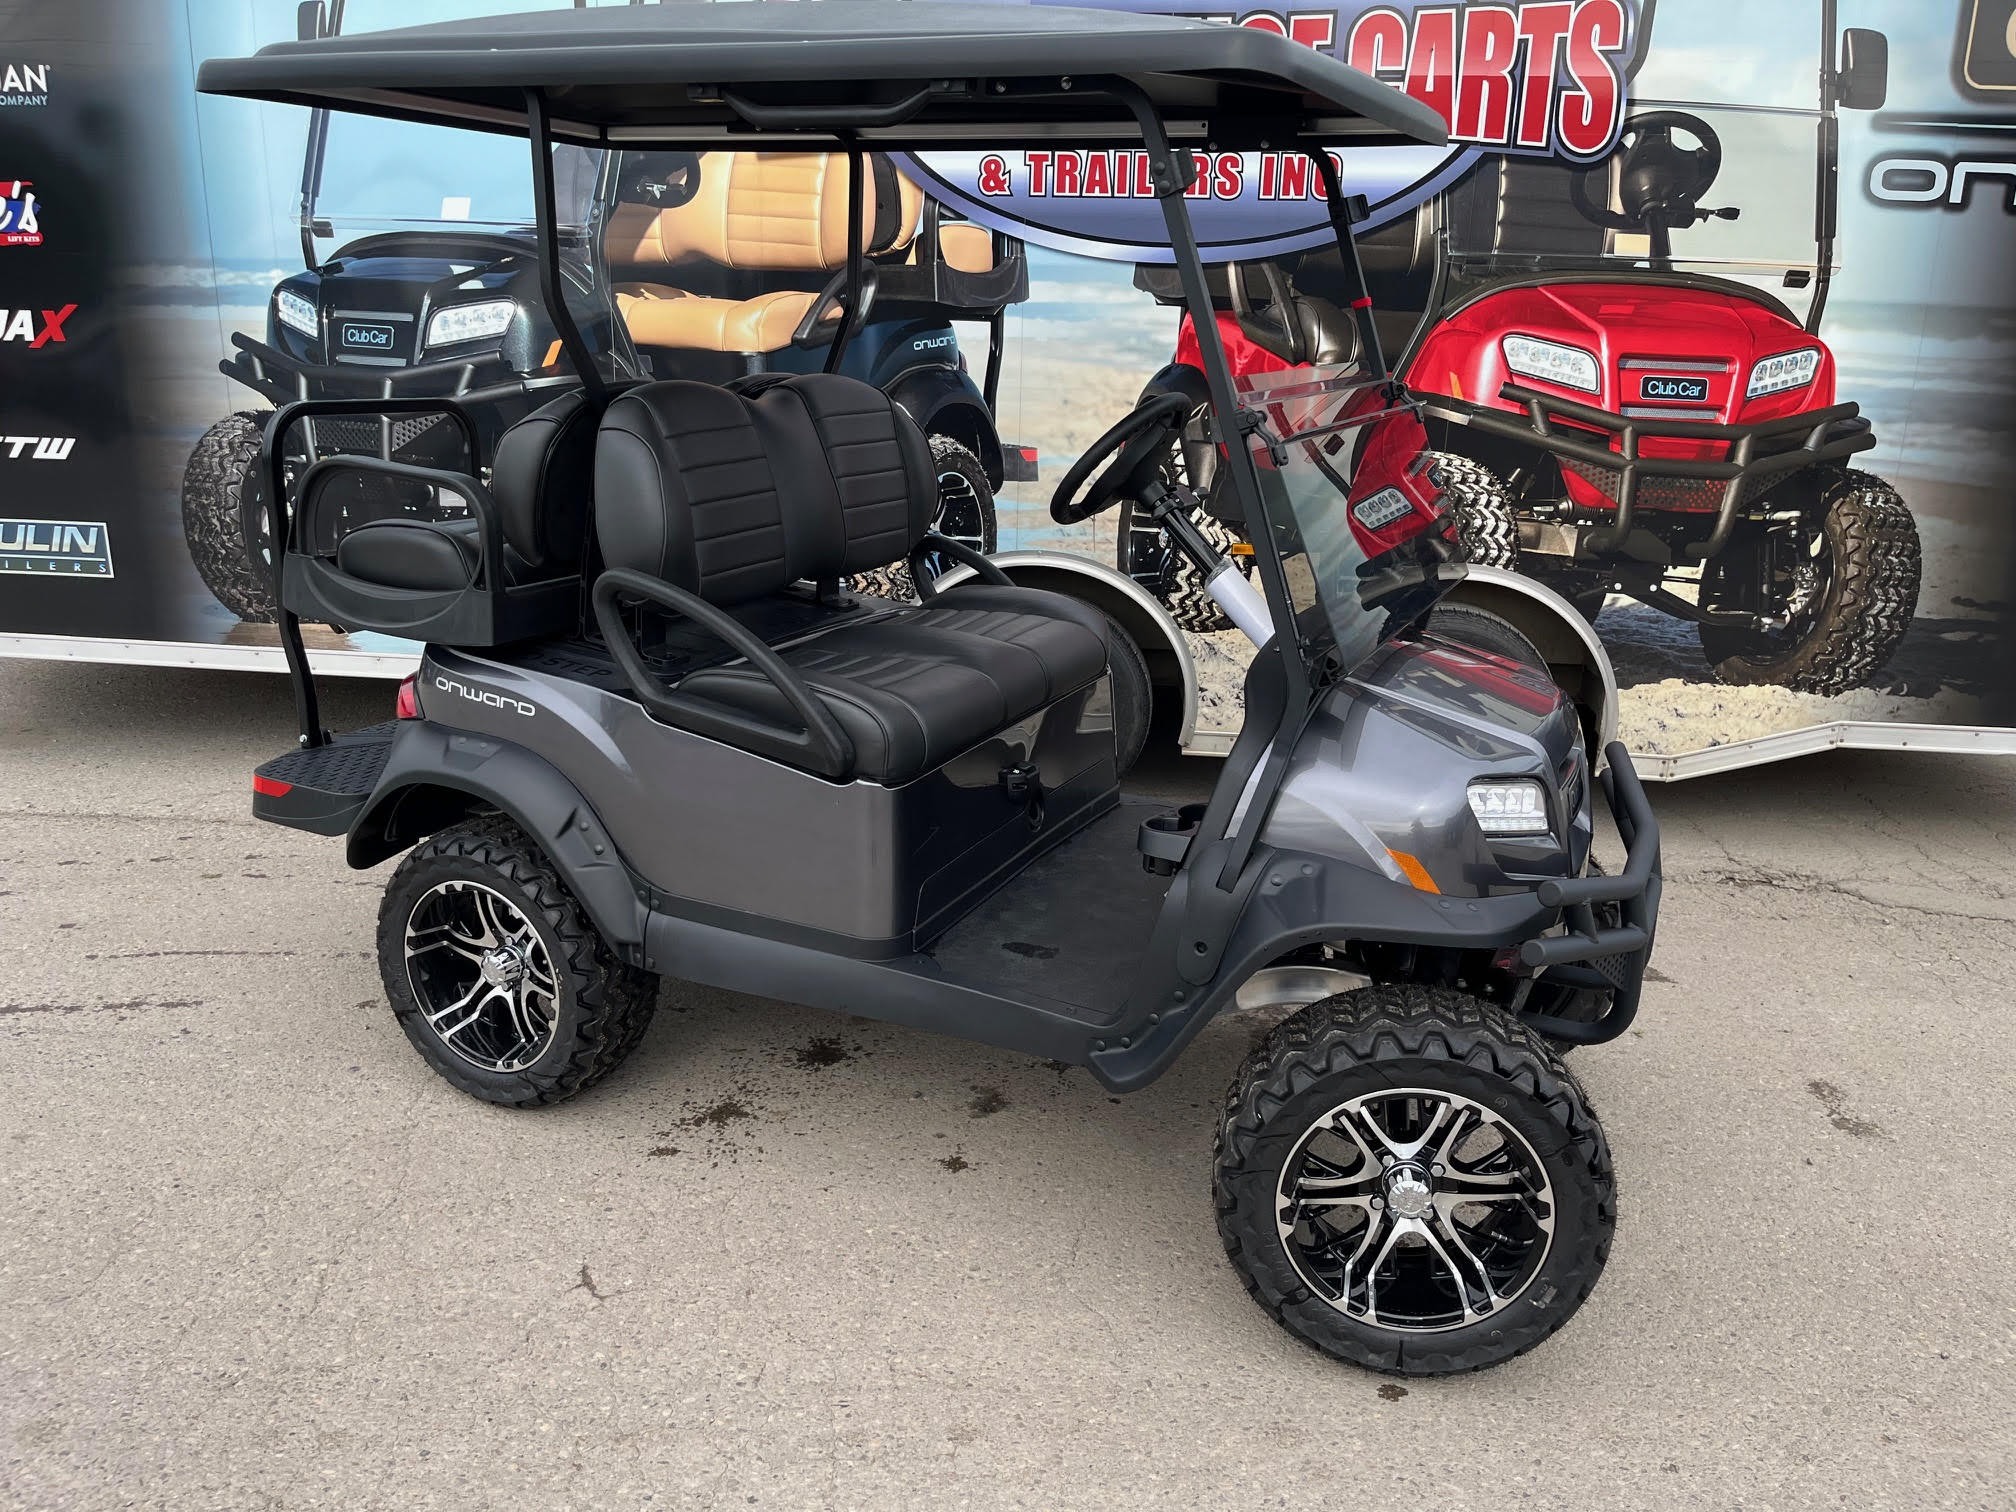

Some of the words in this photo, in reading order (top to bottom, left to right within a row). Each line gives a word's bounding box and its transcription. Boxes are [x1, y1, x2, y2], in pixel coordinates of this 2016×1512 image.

[0, 64, 48, 92] AN
[980, 154, 1013, 197] &
[1026, 151, 1243, 199] TRAILRS
[347, 328, 370, 343] Club
[370, 330, 388, 344] Car
[1647, 380, 1678, 396] Club
[1678, 381, 1702, 397] Car
[0, 436, 76, 460] TW
